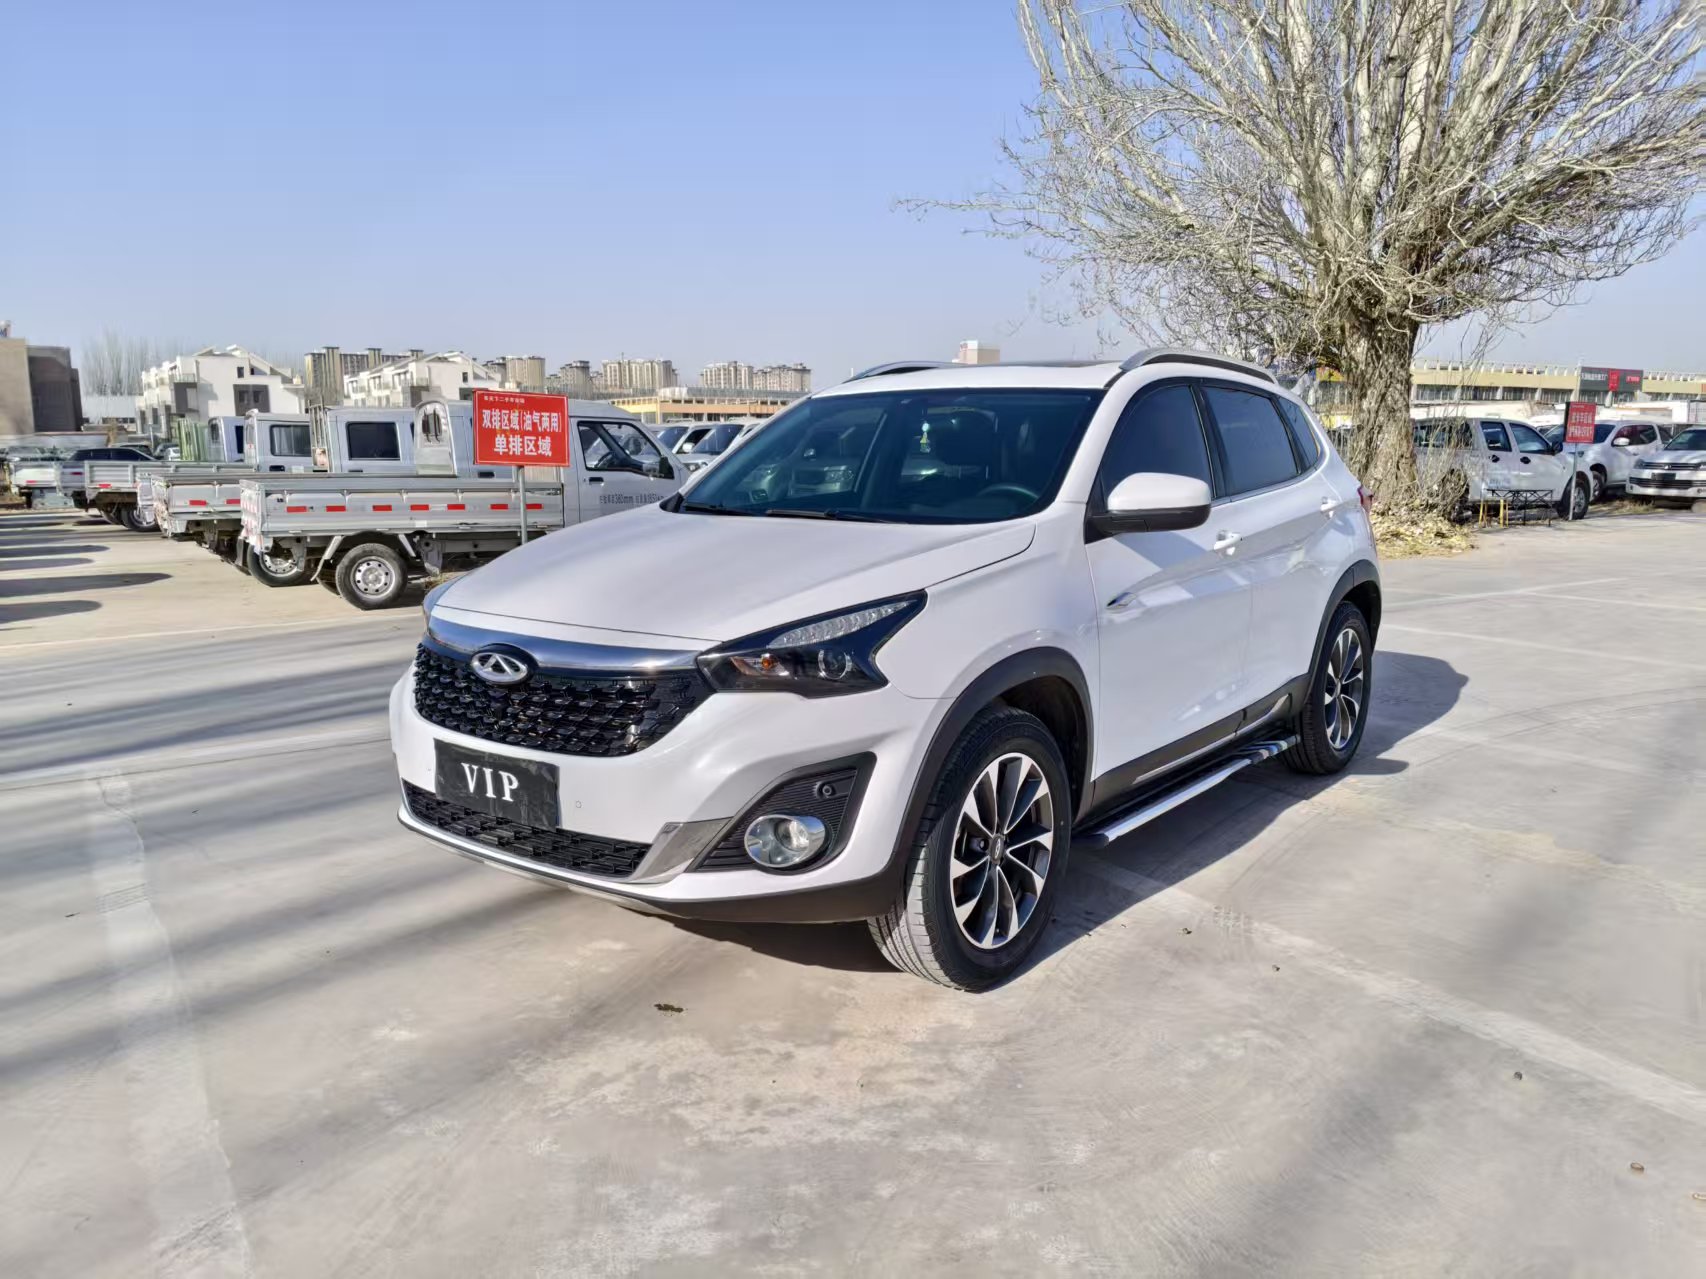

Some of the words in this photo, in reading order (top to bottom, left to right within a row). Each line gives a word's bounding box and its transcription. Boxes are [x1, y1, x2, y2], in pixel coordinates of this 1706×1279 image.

[493, 434, 552, 457] 单排区域
[461, 762, 519, 802] VIP
